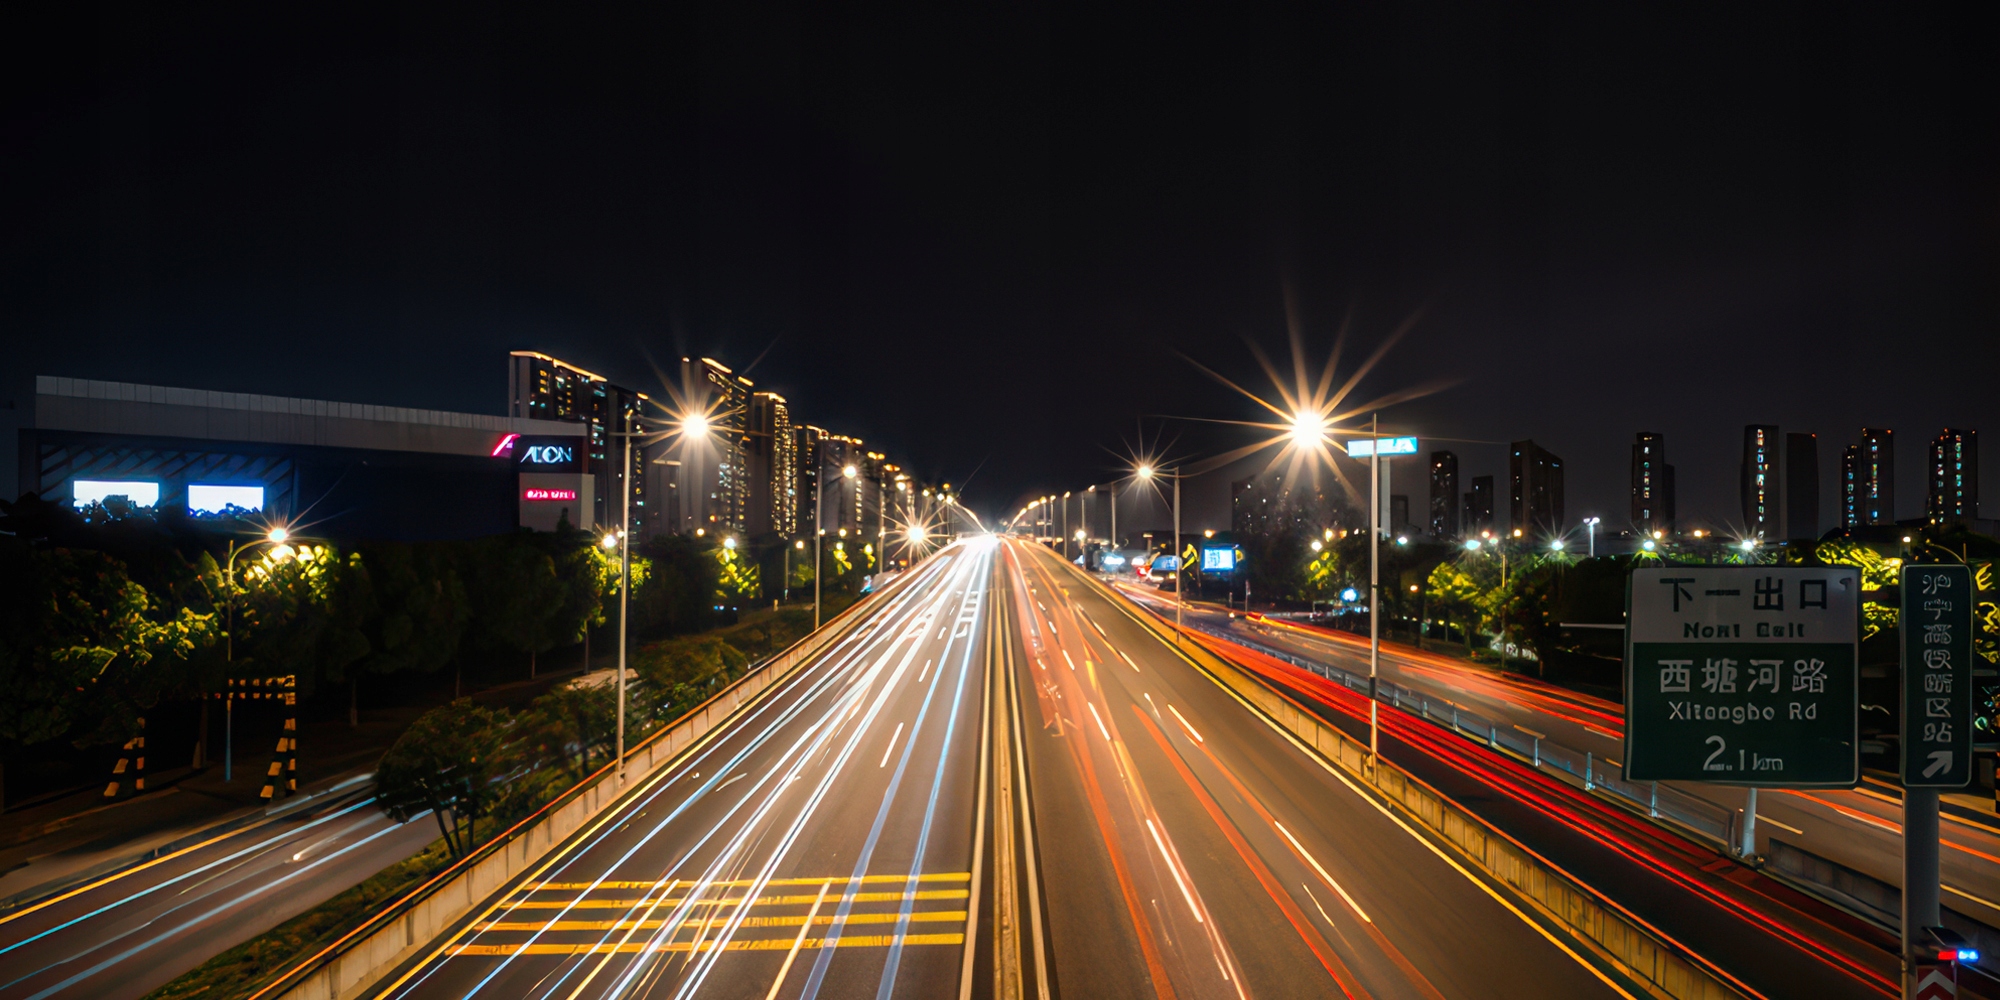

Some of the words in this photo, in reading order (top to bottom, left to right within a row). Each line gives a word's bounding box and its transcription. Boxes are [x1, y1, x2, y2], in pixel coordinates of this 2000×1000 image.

[1659, 576, 1827, 612] 下一出口
[1657, 658, 1828, 693] 西塘河路
[1789, 702, 1817, 720] Rd
